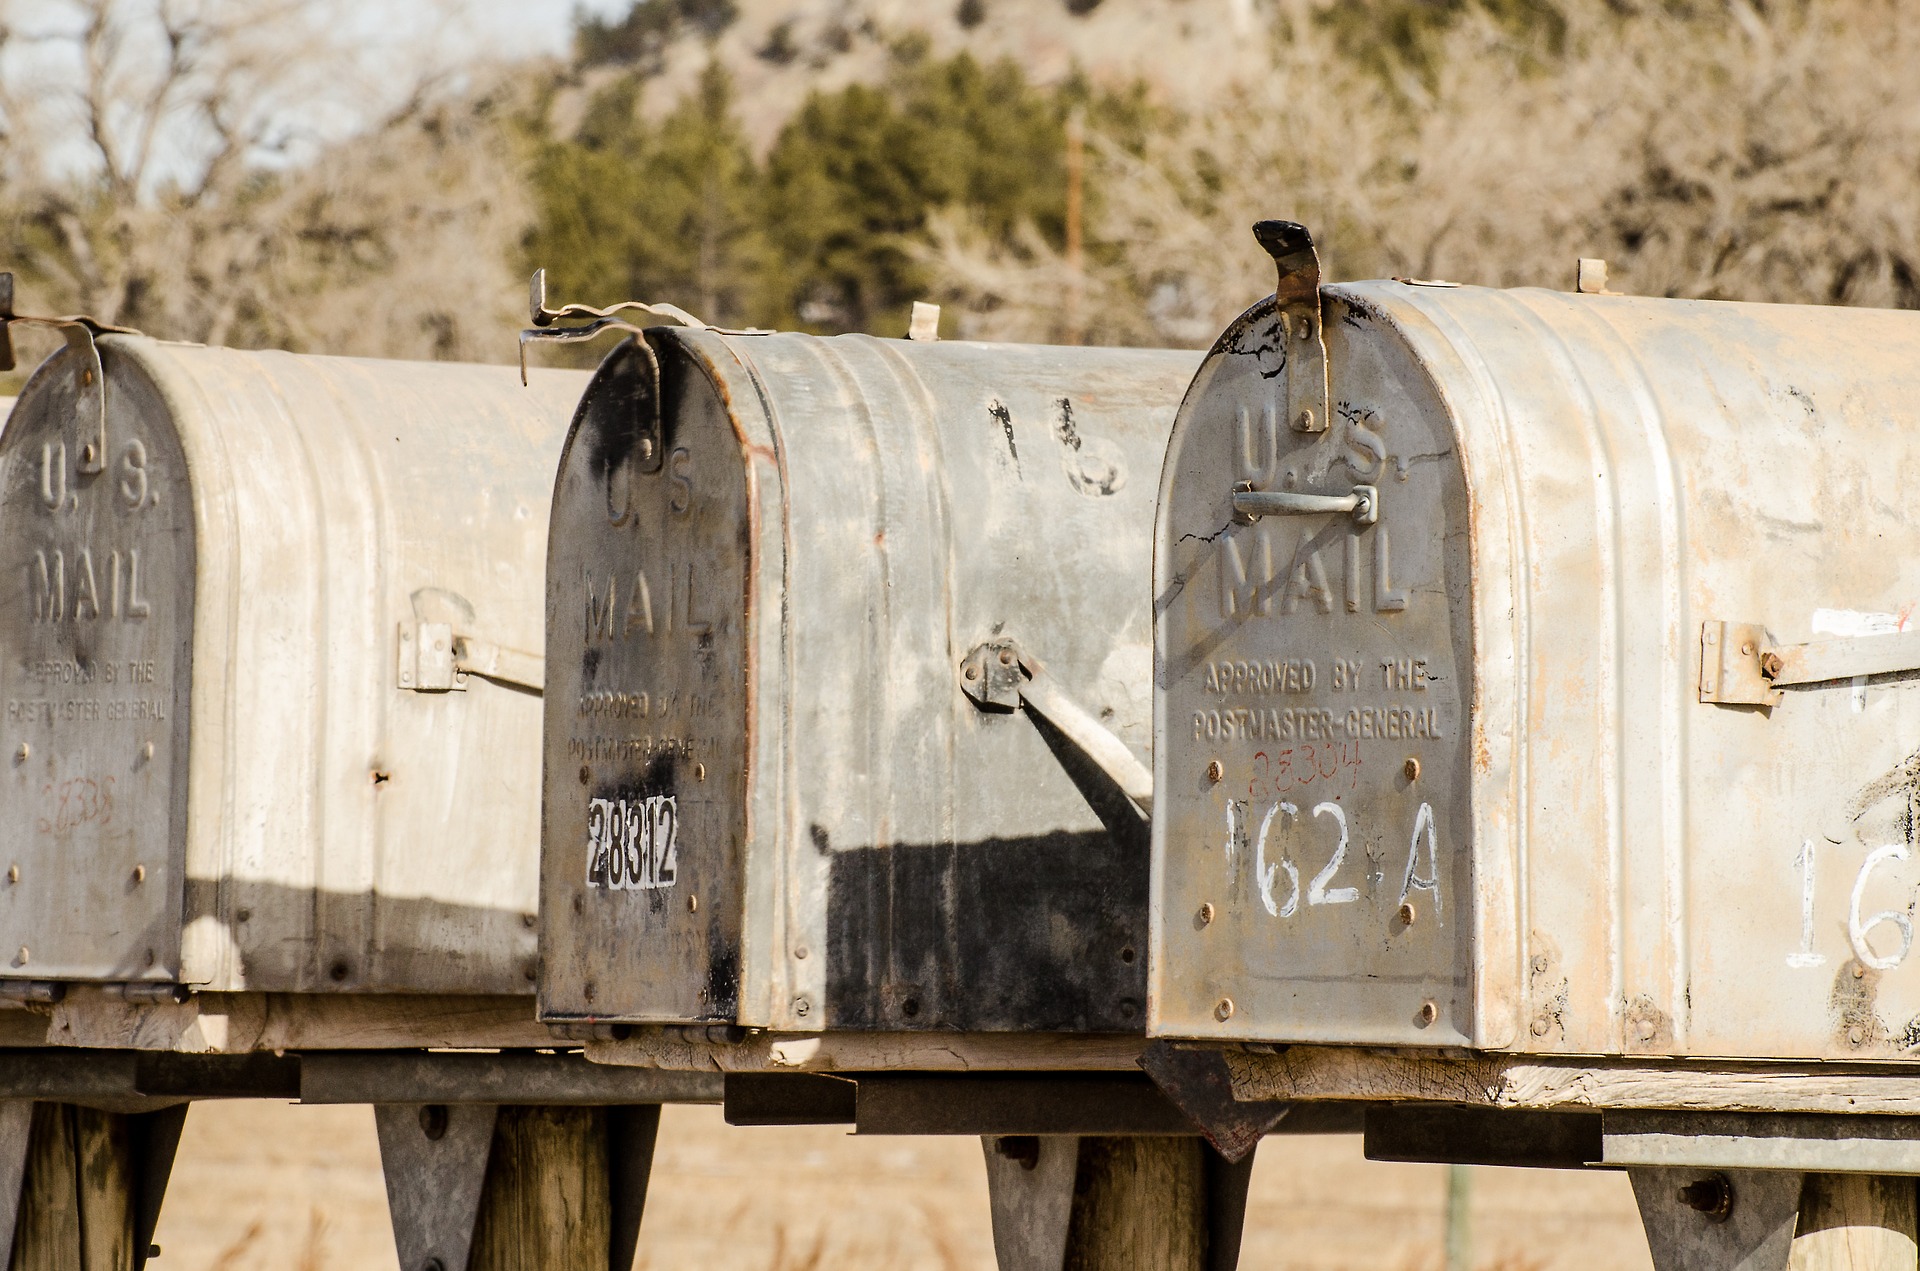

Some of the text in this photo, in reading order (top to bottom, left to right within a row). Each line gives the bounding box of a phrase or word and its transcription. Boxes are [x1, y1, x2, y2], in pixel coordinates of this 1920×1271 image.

[34, 549, 150, 623] MAIL
[583, 562, 714, 645] MAIL
[1219, 525, 1409, 617] MAIL
[129, 660, 156, 685] THE
[1203, 656, 1430, 695] APPROVED BY THE
[1191, 706, 1442, 742] POSTMASTER-GENERAL
[1249, 740, 1363, 797] 28304
[587, 797, 678, 890] 28312
[1224, 799, 1444, 929] 162 A
[1785, 838, 1915, 970] 16
